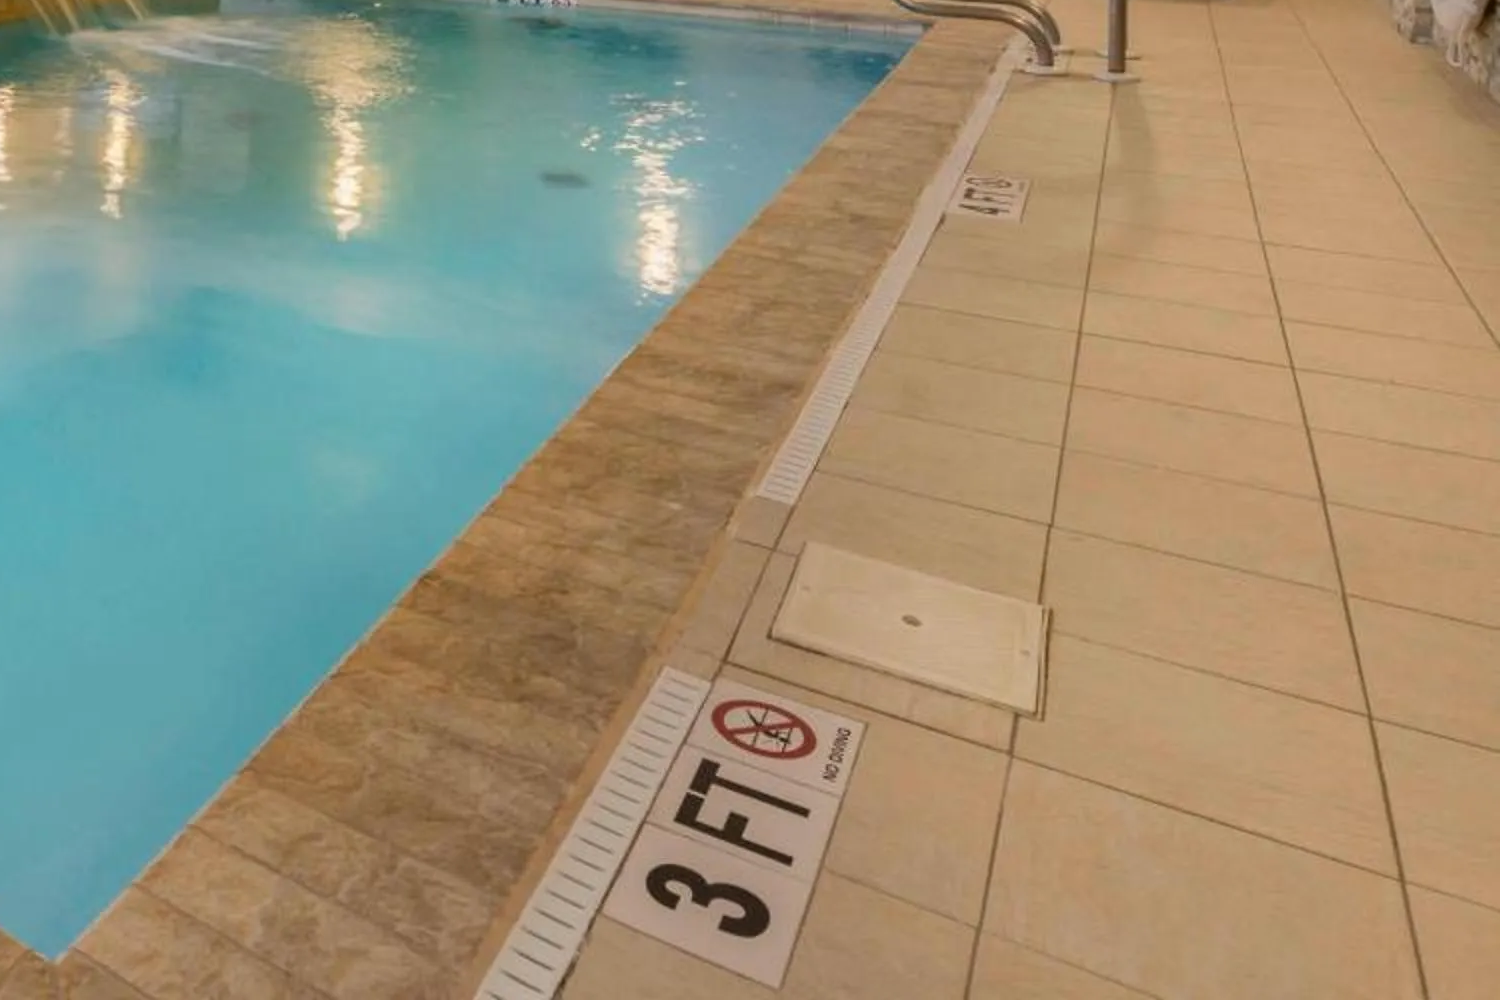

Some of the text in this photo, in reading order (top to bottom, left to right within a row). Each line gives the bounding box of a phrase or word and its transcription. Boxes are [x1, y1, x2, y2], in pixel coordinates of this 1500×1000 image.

[822, 763, 840, 783] NO
[645, 757, 811, 938] 3 FT
